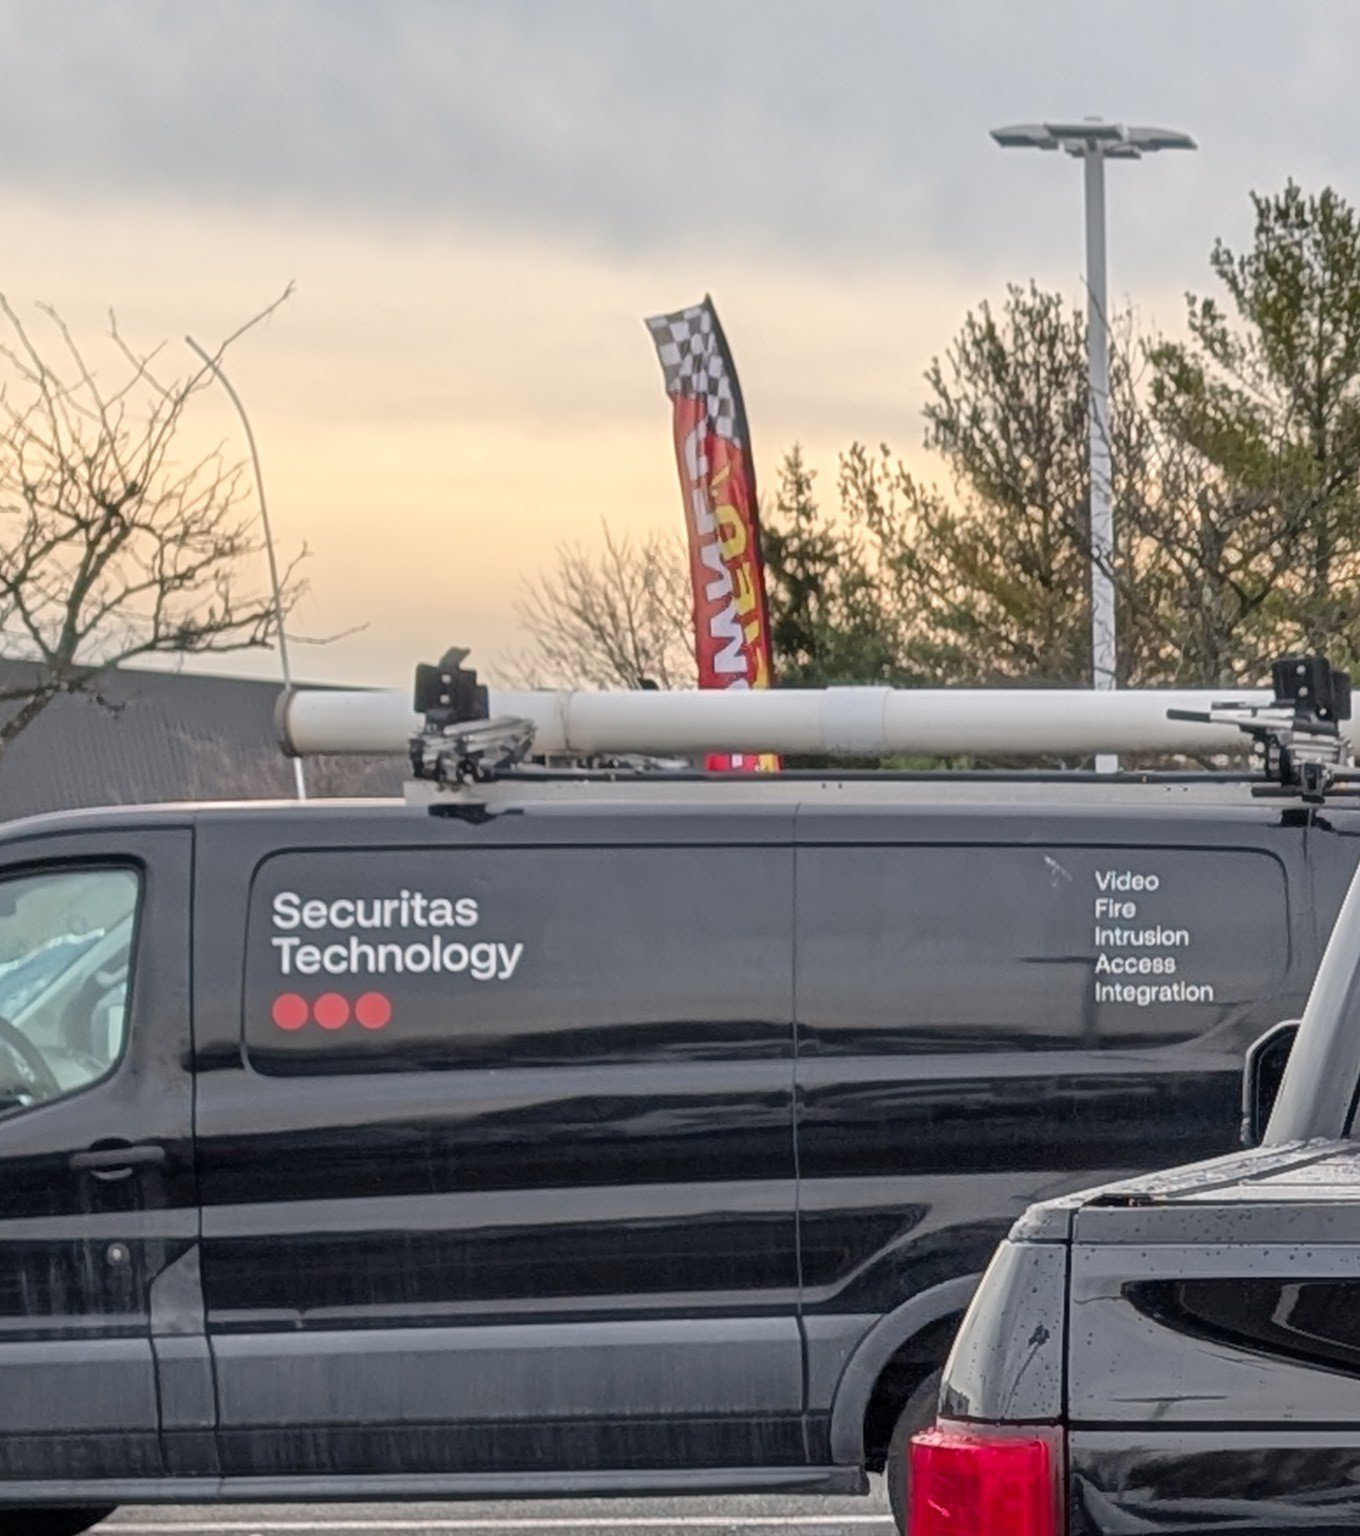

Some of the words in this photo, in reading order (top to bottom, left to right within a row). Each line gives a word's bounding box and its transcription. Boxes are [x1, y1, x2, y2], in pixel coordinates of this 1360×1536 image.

[1095, 871, 1159, 891] Video
[272, 890, 478, 929] Securitas
[1095, 898, 1136, 918] Fire
[1095, 925, 1189, 946] Intrusion
[272, 935, 523, 980] Technology
[1095, 953, 1176, 974] Access
[1095, 981, 1214, 1006] Integration
